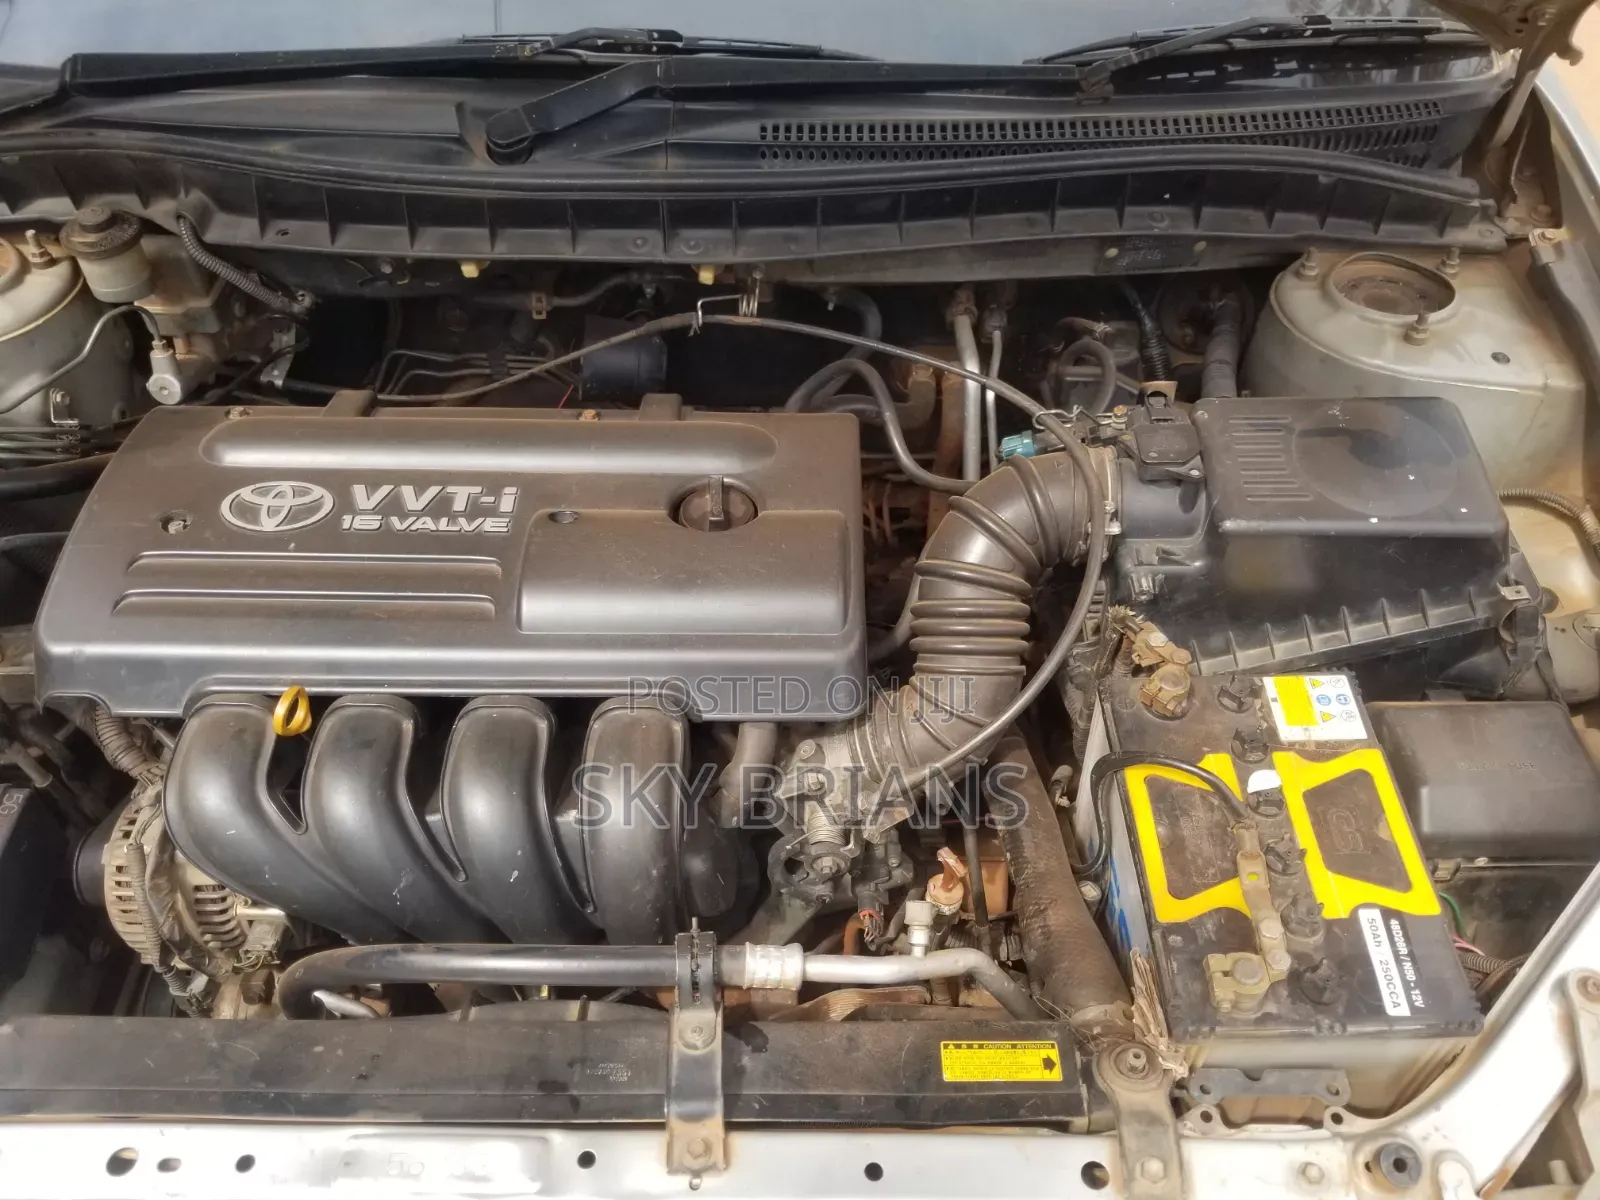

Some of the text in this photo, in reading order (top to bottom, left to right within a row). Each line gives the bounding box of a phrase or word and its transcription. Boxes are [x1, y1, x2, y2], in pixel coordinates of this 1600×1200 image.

[351, 484, 519, 513] VVT-i
[341, 514, 511, 533] 16 VALVE
[1366, 917, 1401, 1008] 50Ah 250CCA
[1410, 989, 1426, 1008] 12V
